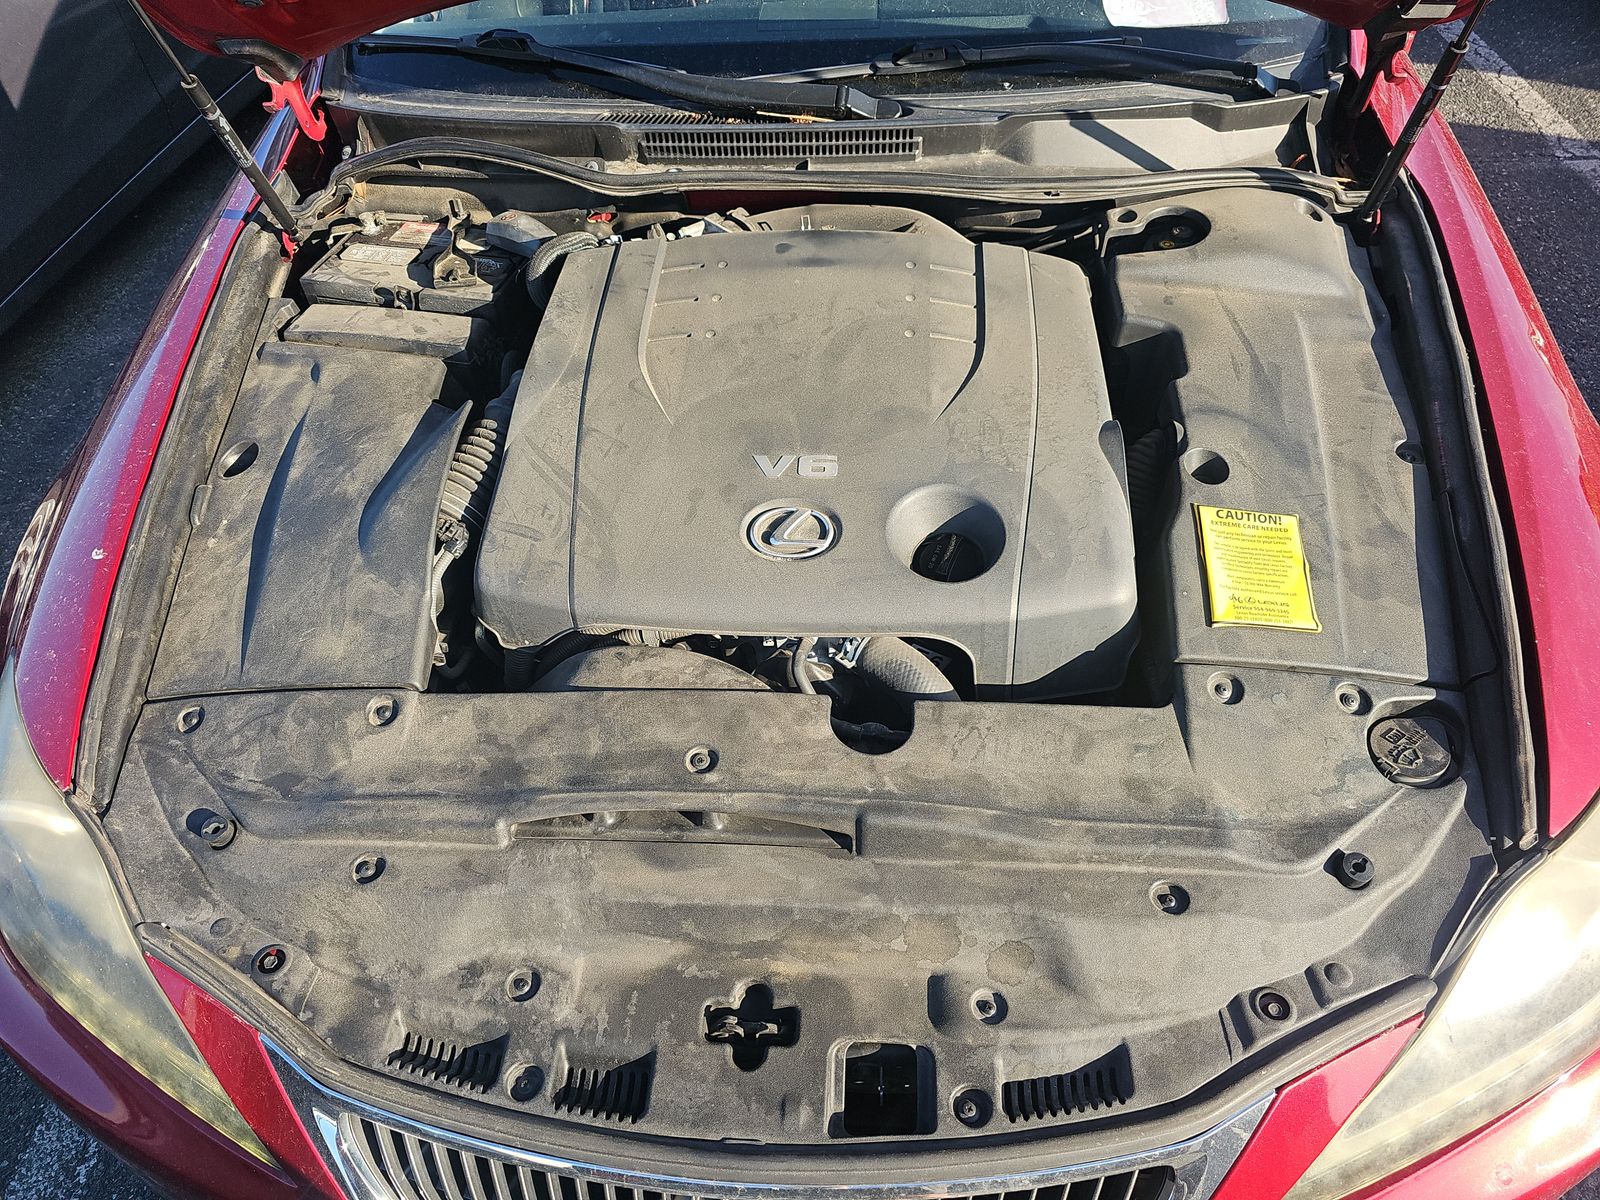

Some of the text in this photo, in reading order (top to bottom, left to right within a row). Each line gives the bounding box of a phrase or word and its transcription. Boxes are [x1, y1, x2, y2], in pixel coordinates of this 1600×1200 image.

[752, 455, 838, 478] V6
[1211, 520, 1241, 528] EXTREME
[1216, 509, 1282, 525] CAUTION!
